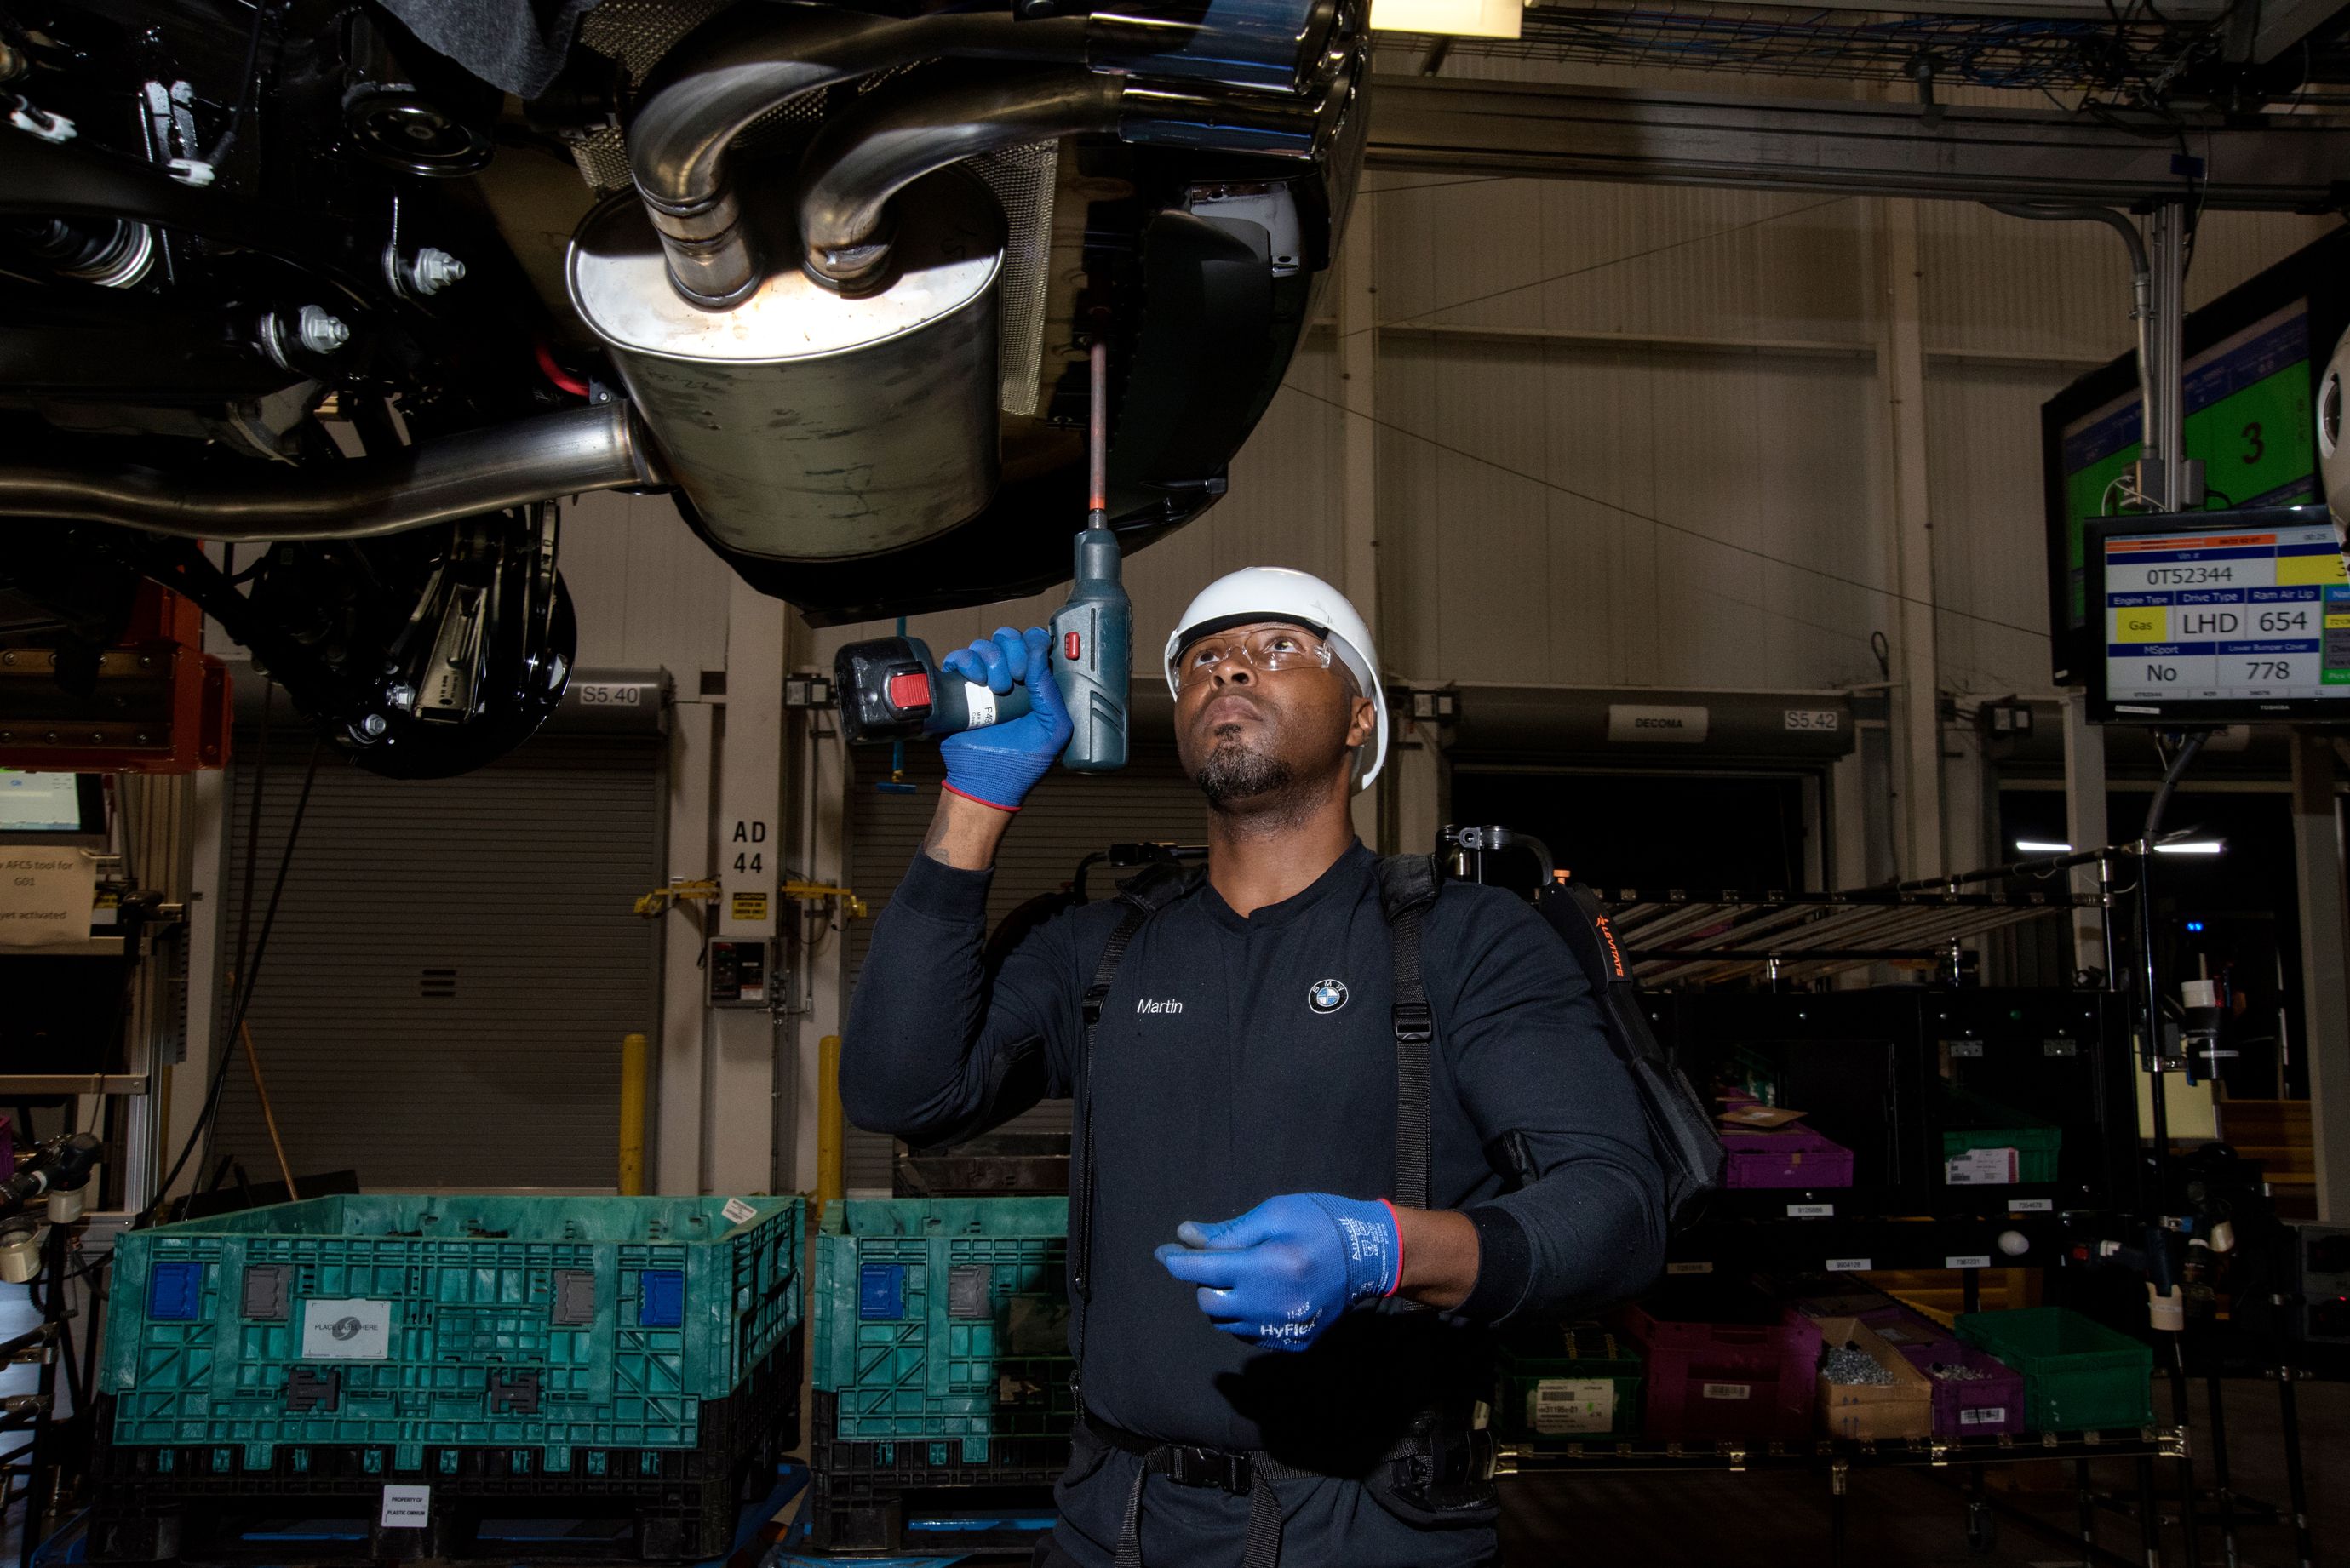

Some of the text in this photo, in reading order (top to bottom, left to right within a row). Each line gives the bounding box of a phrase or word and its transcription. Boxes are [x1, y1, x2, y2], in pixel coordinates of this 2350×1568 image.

[2242, 422, 2264, 464] 3
[2147, 566, 2232, 586] 0T52344
[2113, 596, 2168, 606] Engine Type
[2183, 592, 2238, 603] Drive Type
[2253, 590, 2315, 600] Ram Air Lip
[2129, 621, 2152, 631] Gas
[2183, 613, 2238, 634] LHD
[2260, 611, 2307, 632] 654
[2144, 645, 2179, 655] MSport
[2255, 644, 2284, 652] Bumper
[2147, 665, 2177, 682] No
[2246, 661, 2290, 680] 778
[582, 686, 638, 704] S5.40
[1635, 718, 1683, 729] DECOMA
[1788, 712, 1836, 729] S5.42
[733, 821, 765, 842] AD
[5, 861, 32, 870] AFCS
[35, 860, 54, 870] tool
[58, 860, 73, 870] for
[734, 853, 762, 873] 44
[0, 910, 66, 921] yet activated
[1601, 925, 1625, 977] LEVITATE
[1136, 998, 1184, 1014] Martin
[1259, 1320, 1316, 1338] HyFlex
